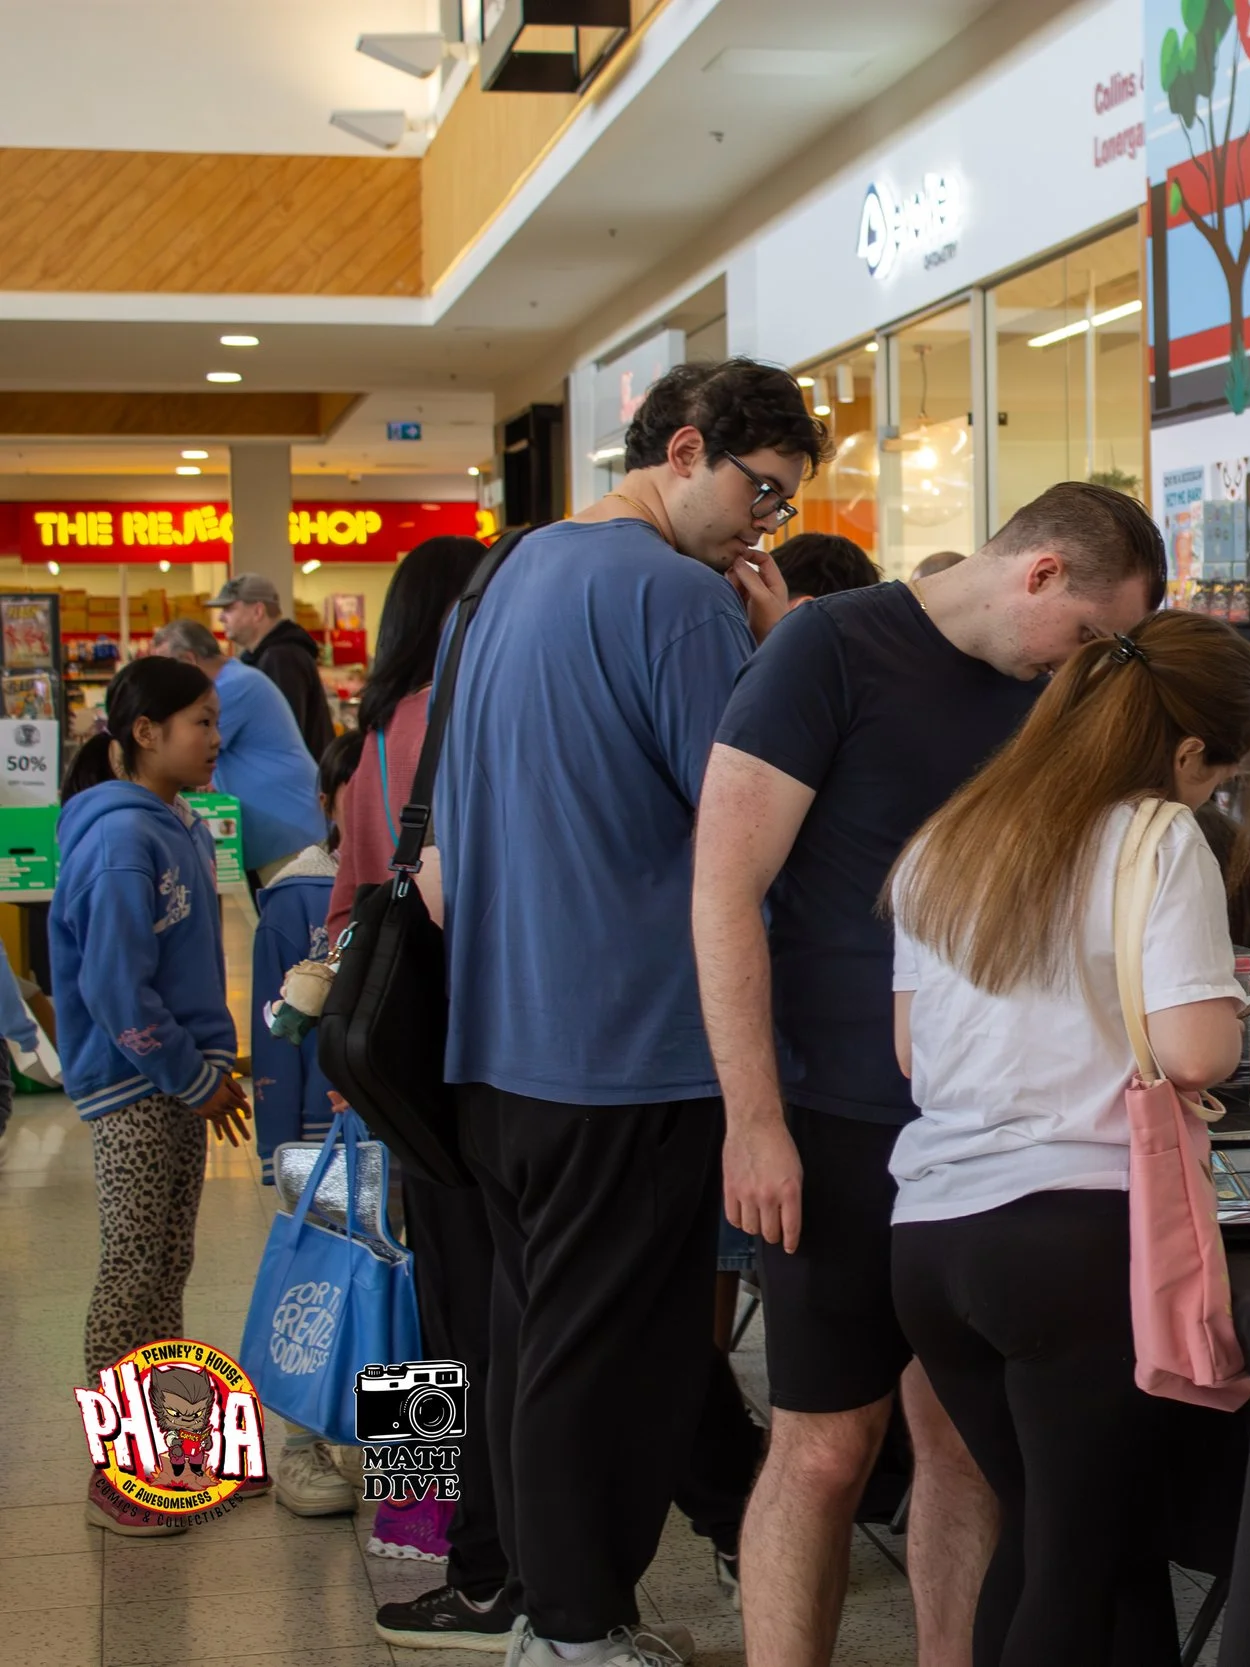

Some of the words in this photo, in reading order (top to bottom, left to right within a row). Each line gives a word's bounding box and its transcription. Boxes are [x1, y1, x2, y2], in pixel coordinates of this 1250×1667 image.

[34, 511, 114, 546] THE
[122, 505, 233, 546] REJEC
[6, 755, 47, 773] 50%
[282, 1281, 329, 1304] FOR
[272, 1304, 336, 1350] GREATE
[270, 1333, 329, 1376] GOODNESS
